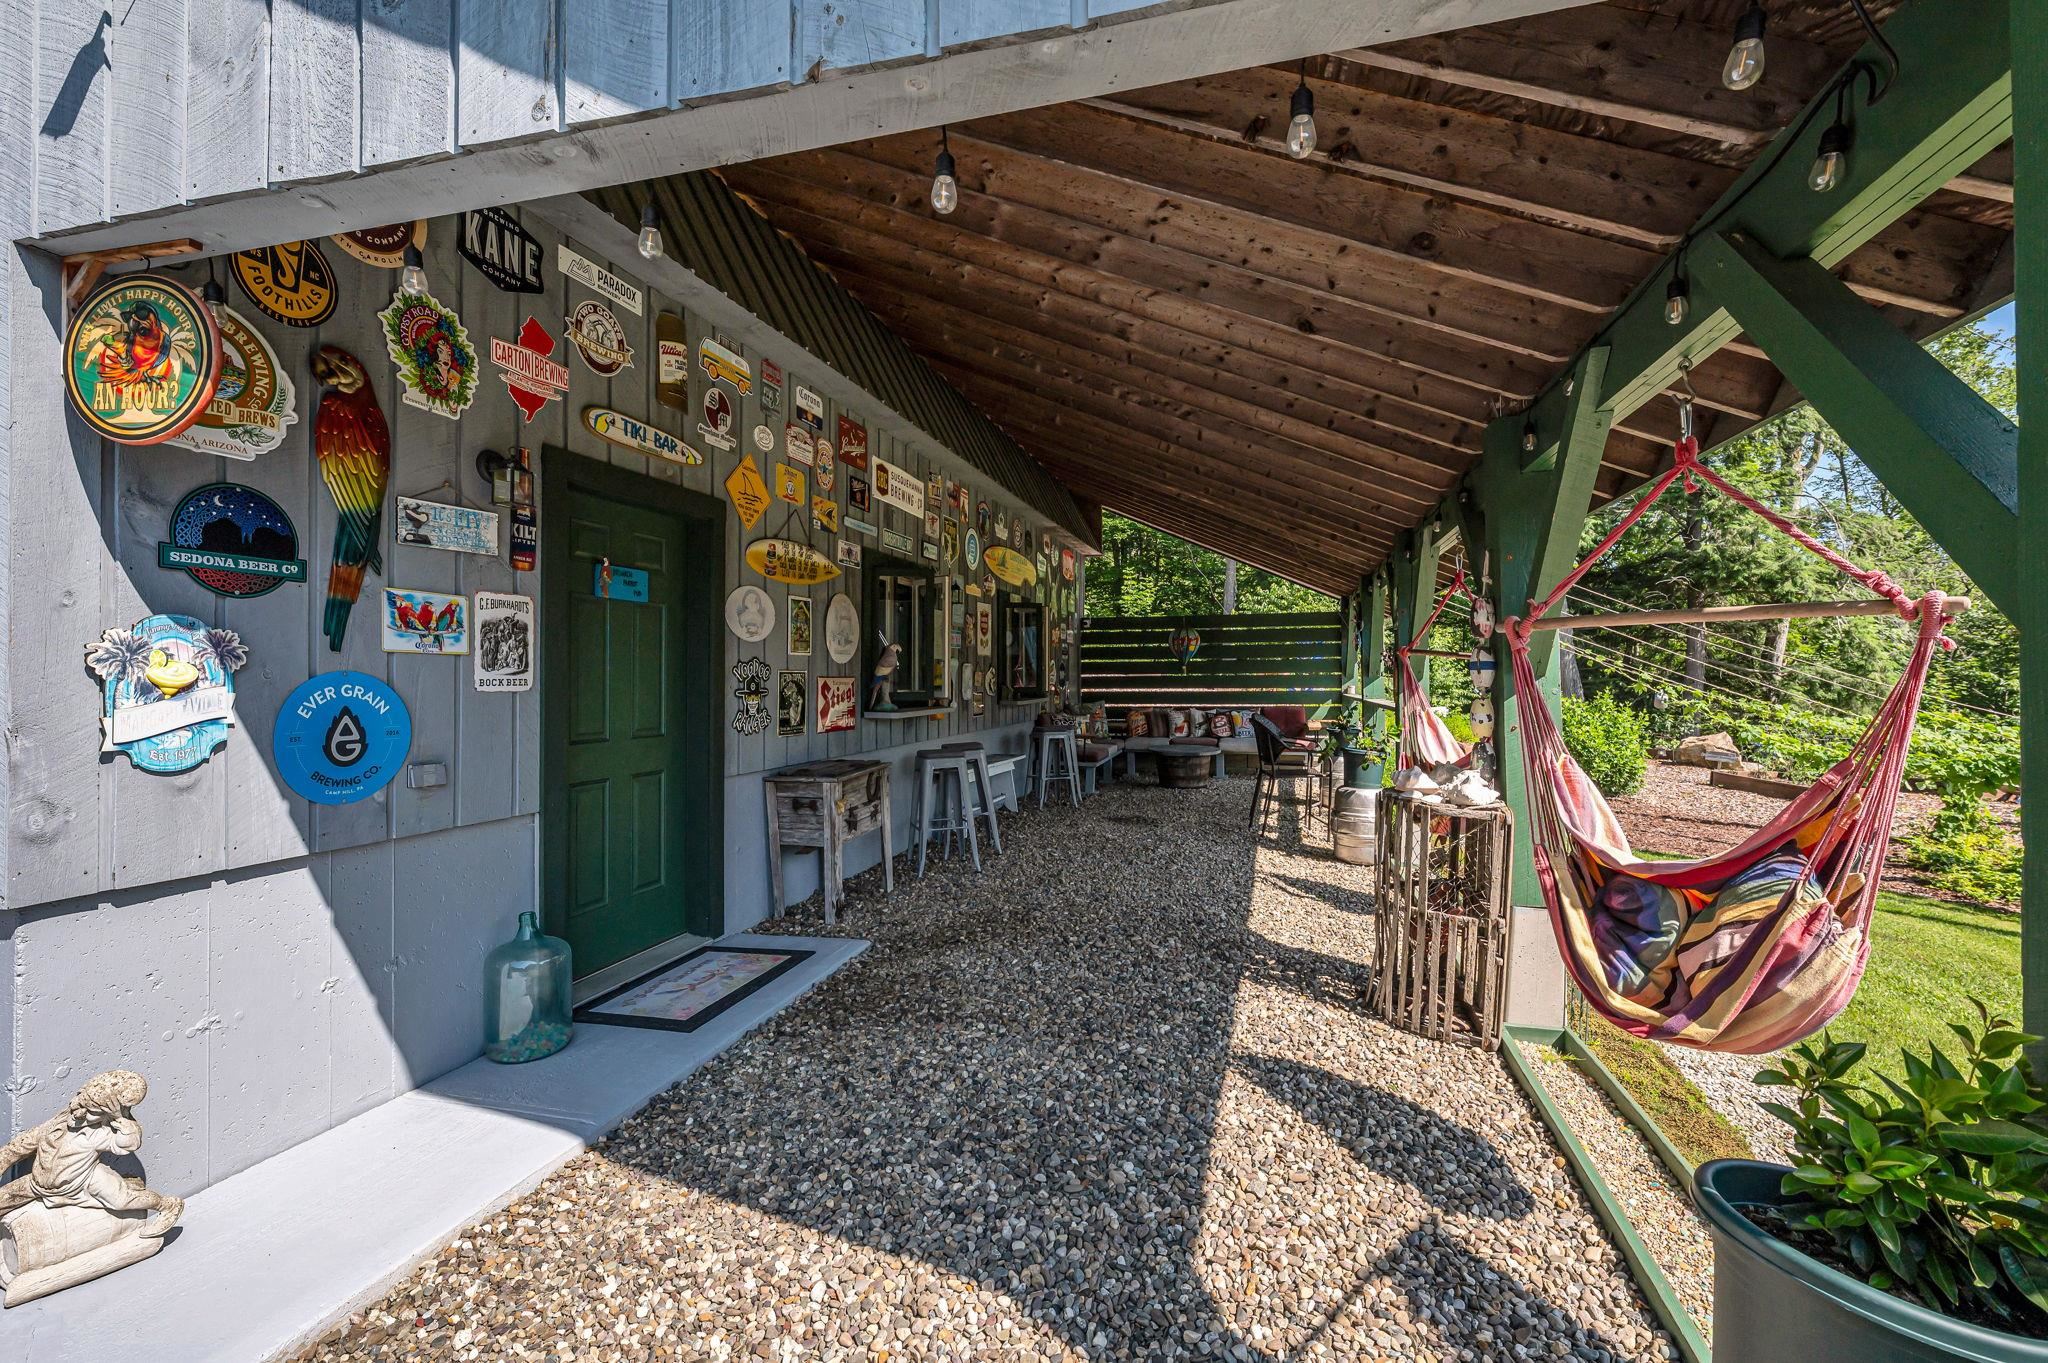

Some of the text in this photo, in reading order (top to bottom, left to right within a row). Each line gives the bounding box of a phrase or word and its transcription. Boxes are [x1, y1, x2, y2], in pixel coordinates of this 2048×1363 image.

[484, 208, 520, 232] BREWING
[368, 226, 406, 245] COMPANY
[358, 251, 402, 264] CAROLIN
[466, 211, 539, 286] KANE
[310, 272, 320, 280] NC
[482, 264, 521, 287] COMPANY
[597, 270, 636, 303] PARADOX
[248, 266, 322, 311] FOOTHILLS
[597, 284, 622, 301] BREWERY
[78, 290, 196, 351] WHY LIMIT HAPPY HOUR TO
[259, 303, 311, 327] BREWING
[401, 306, 439, 346] GYPSY ROAD
[578, 304, 624, 340] TWO GOATS
[224, 321, 268, 398] BREWING
[577, 335, 624, 361] BREWING
[661, 344, 682, 356] Utica
[494, 342, 531, 375] CARTON
[534, 356, 569, 386] BREWING
[93, 383, 179, 410] AN HOUR?
[798, 388, 820, 408] Corona
[238, 408, 276, 428] BREWS
[202, 440, 248, 454] ARIZONA
[620, 417, 646, 443] TIKI
[654, 431, 678, 456] BAR
[890, 472, 922, 494] SUSQUEHANNA
[890, 484, 914, 507] BREWING
[513, 522, 536, 540] KILT
[170, 551, 236, 568] SEDONA
[238, 560, 278, 572] BEER
[490, 598, 529, 615] BURKHARDT'S
[415, 642, 439, 650] Corona
[733, 658, 771, 683] VOODOO
[479, 678, 528, 688] BOCK BEER
[296, 684, 390, 719] EVER GRAIN
[820, 680, 856, 722] Stiegl
[734, 710, 772, 735] RANGER
[150, 746, 198, 762] Est. 1977
[310, 765, 382, 788] BREWING CO.
